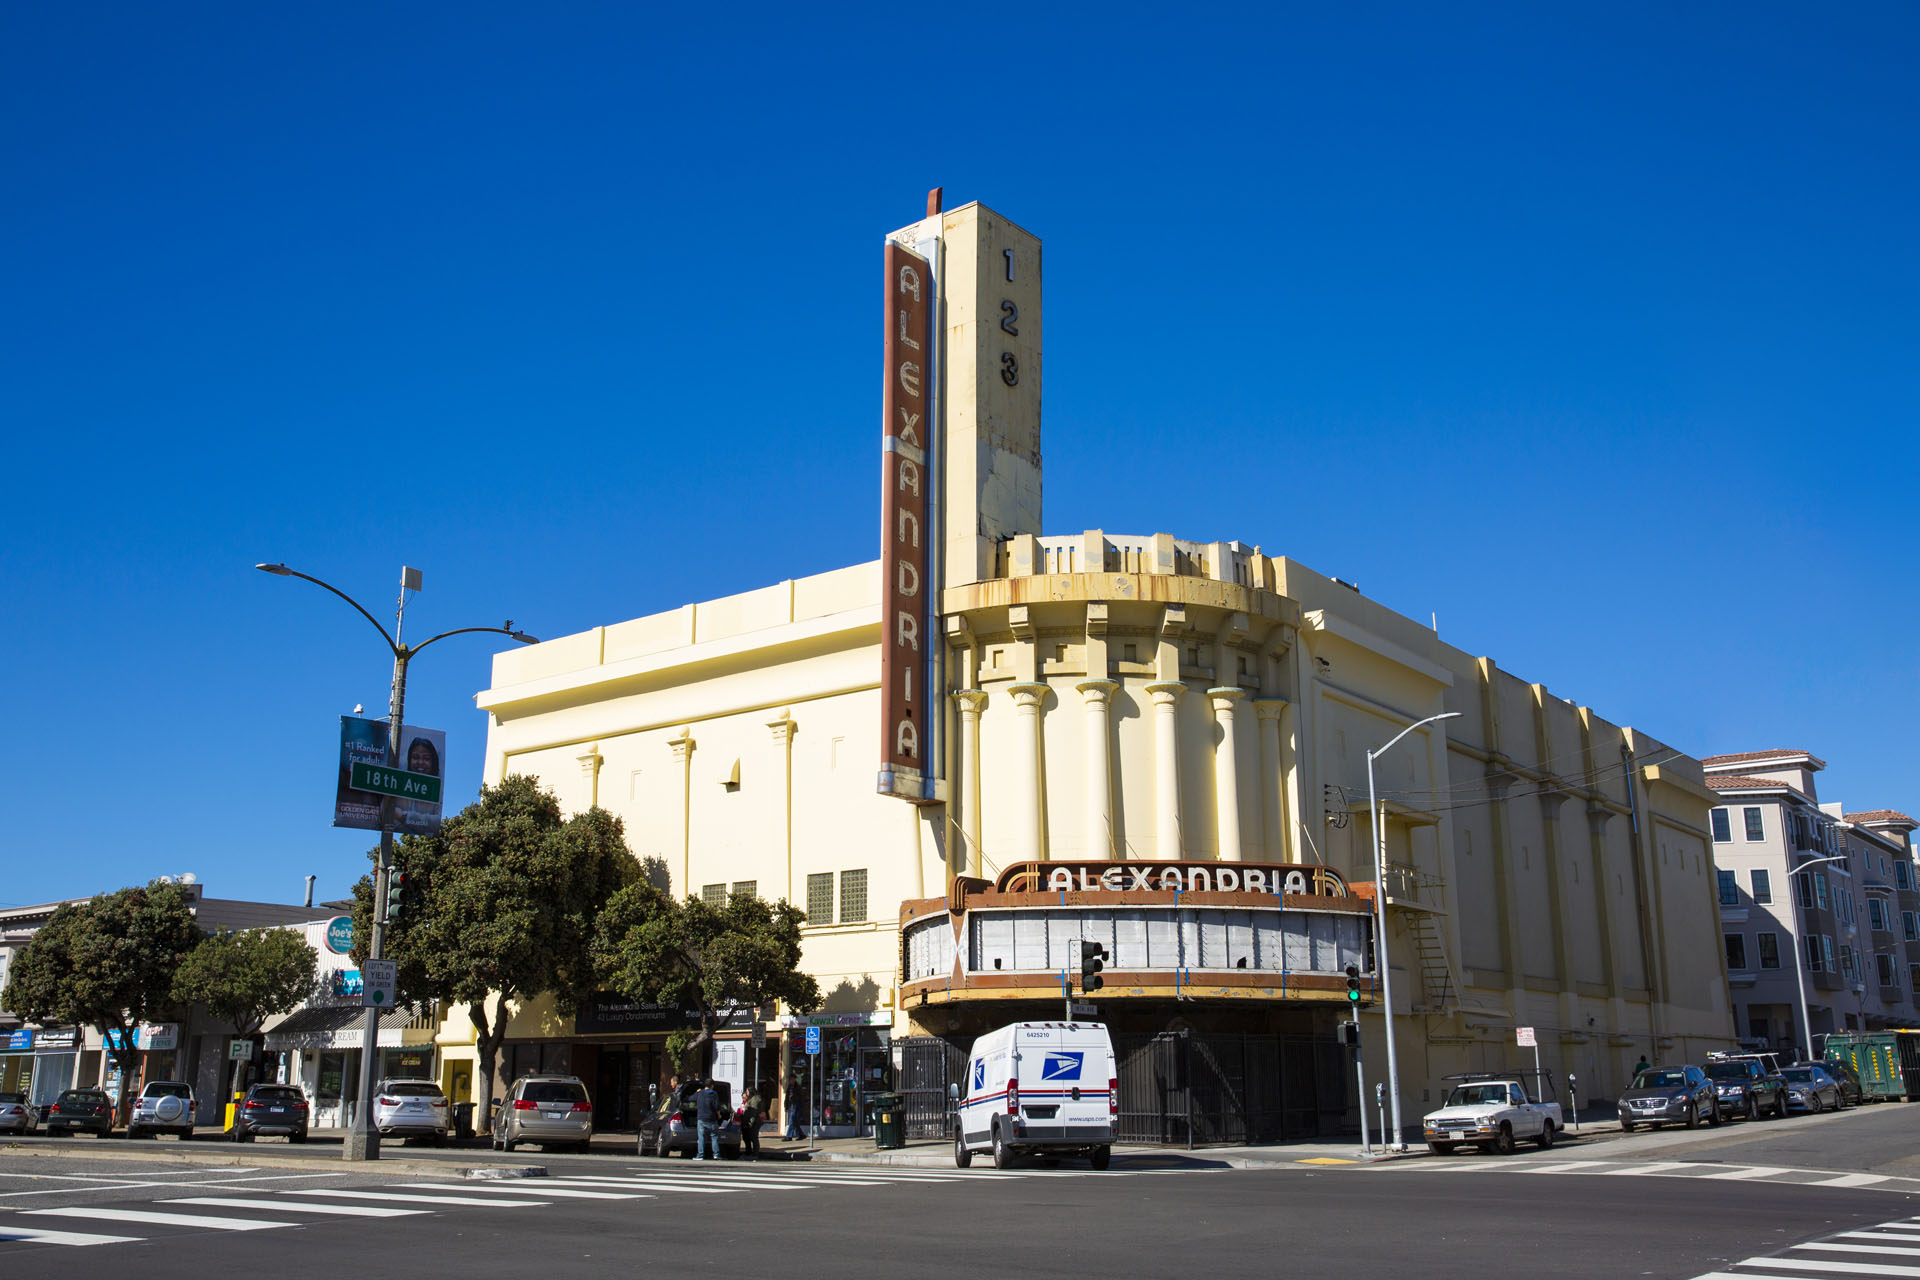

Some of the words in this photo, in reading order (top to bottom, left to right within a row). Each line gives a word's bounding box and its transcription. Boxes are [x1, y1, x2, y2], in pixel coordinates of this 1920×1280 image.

[897, 265, 920, 758] ALEXANDRIA
[356, 742, 385, 754] Ranked
[366, 770, 397, 789] 18th
[404, 778, 428, 794] Ave
[1047, 866, 1307, 896] ALEXANDRIA
[329, 926, 352, 938] Joe's
[370, 971, 391, 980] YIELD
[598, 1003, 609, 1011] The
[641, 1002, 657, 1010] Sales
[606, 1012, 624, 1022] Luxury
[625, 1011, 666, 1020] Condominiums
[837, 1015, 860, 1025] Corner
[232, 1044, 243, 1057] P
